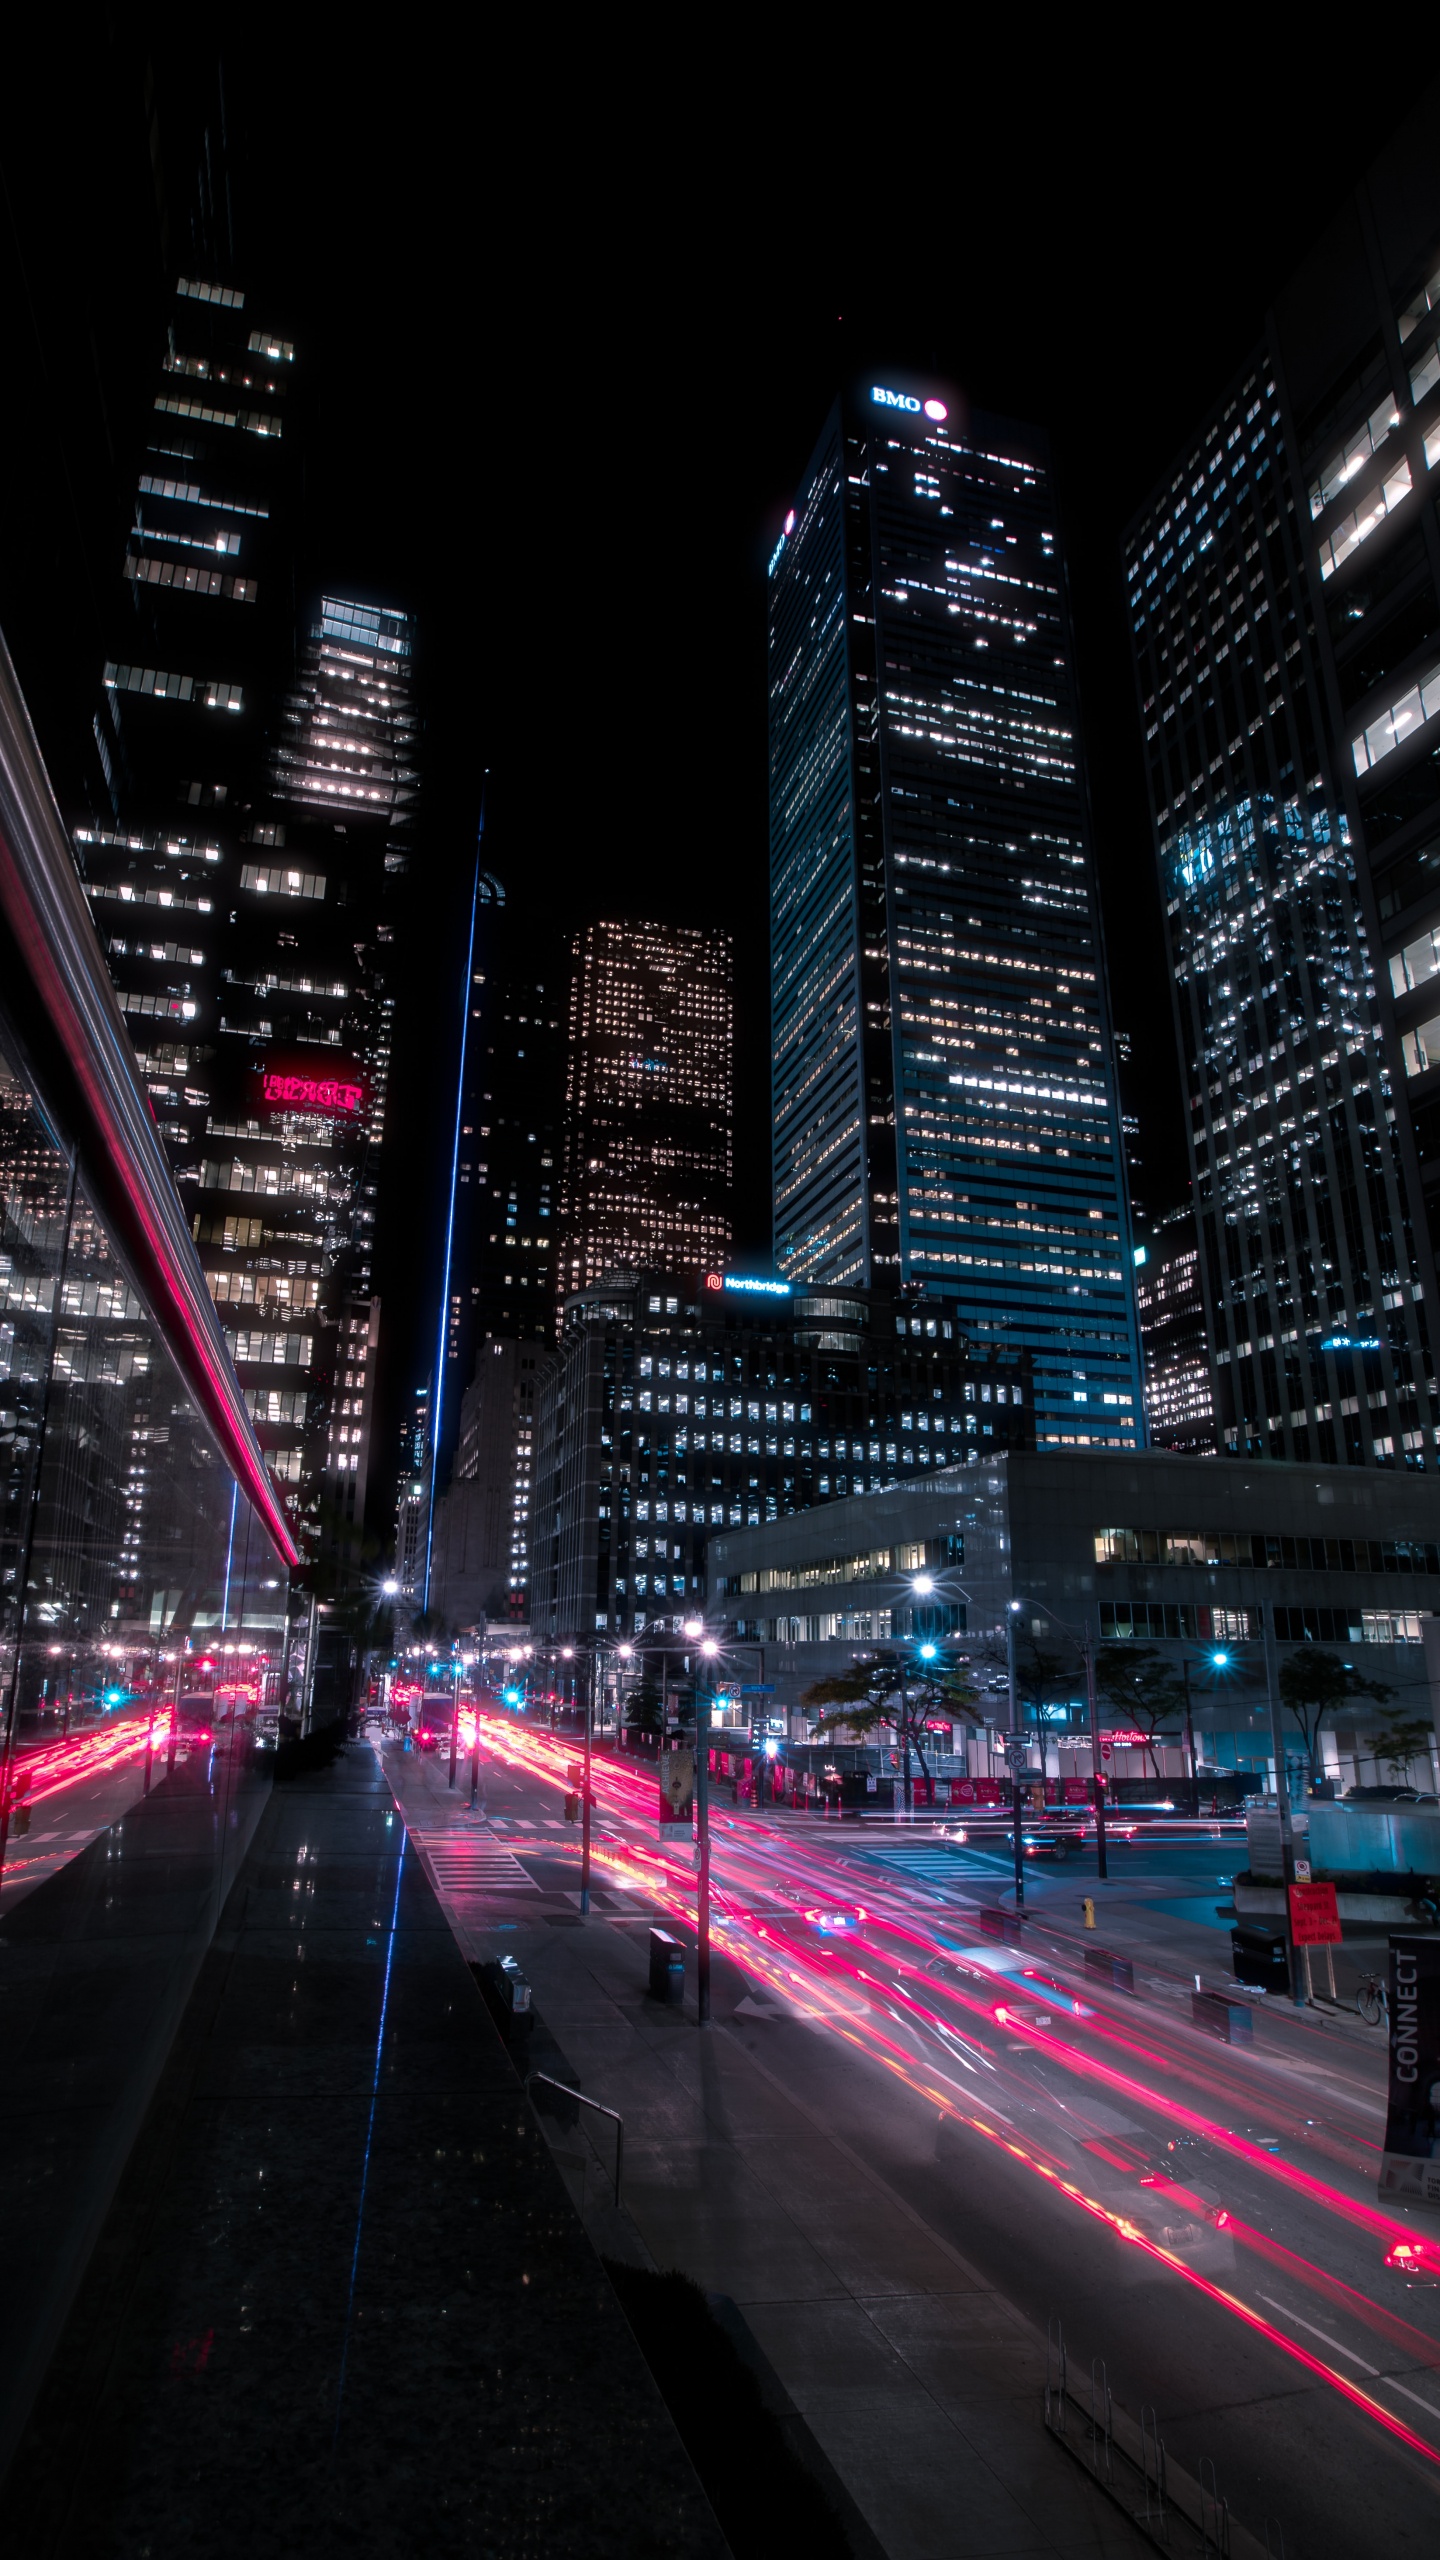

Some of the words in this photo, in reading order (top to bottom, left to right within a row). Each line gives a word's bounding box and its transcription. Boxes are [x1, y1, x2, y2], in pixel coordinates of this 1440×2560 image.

[872, 386, 921, 412] BMO
[725, 1277, 789, 1294] Northbridge
[662, 1754, 670, 1794] ACHIEVE
[1396, 1949, 1419, 2083] CONNECT
